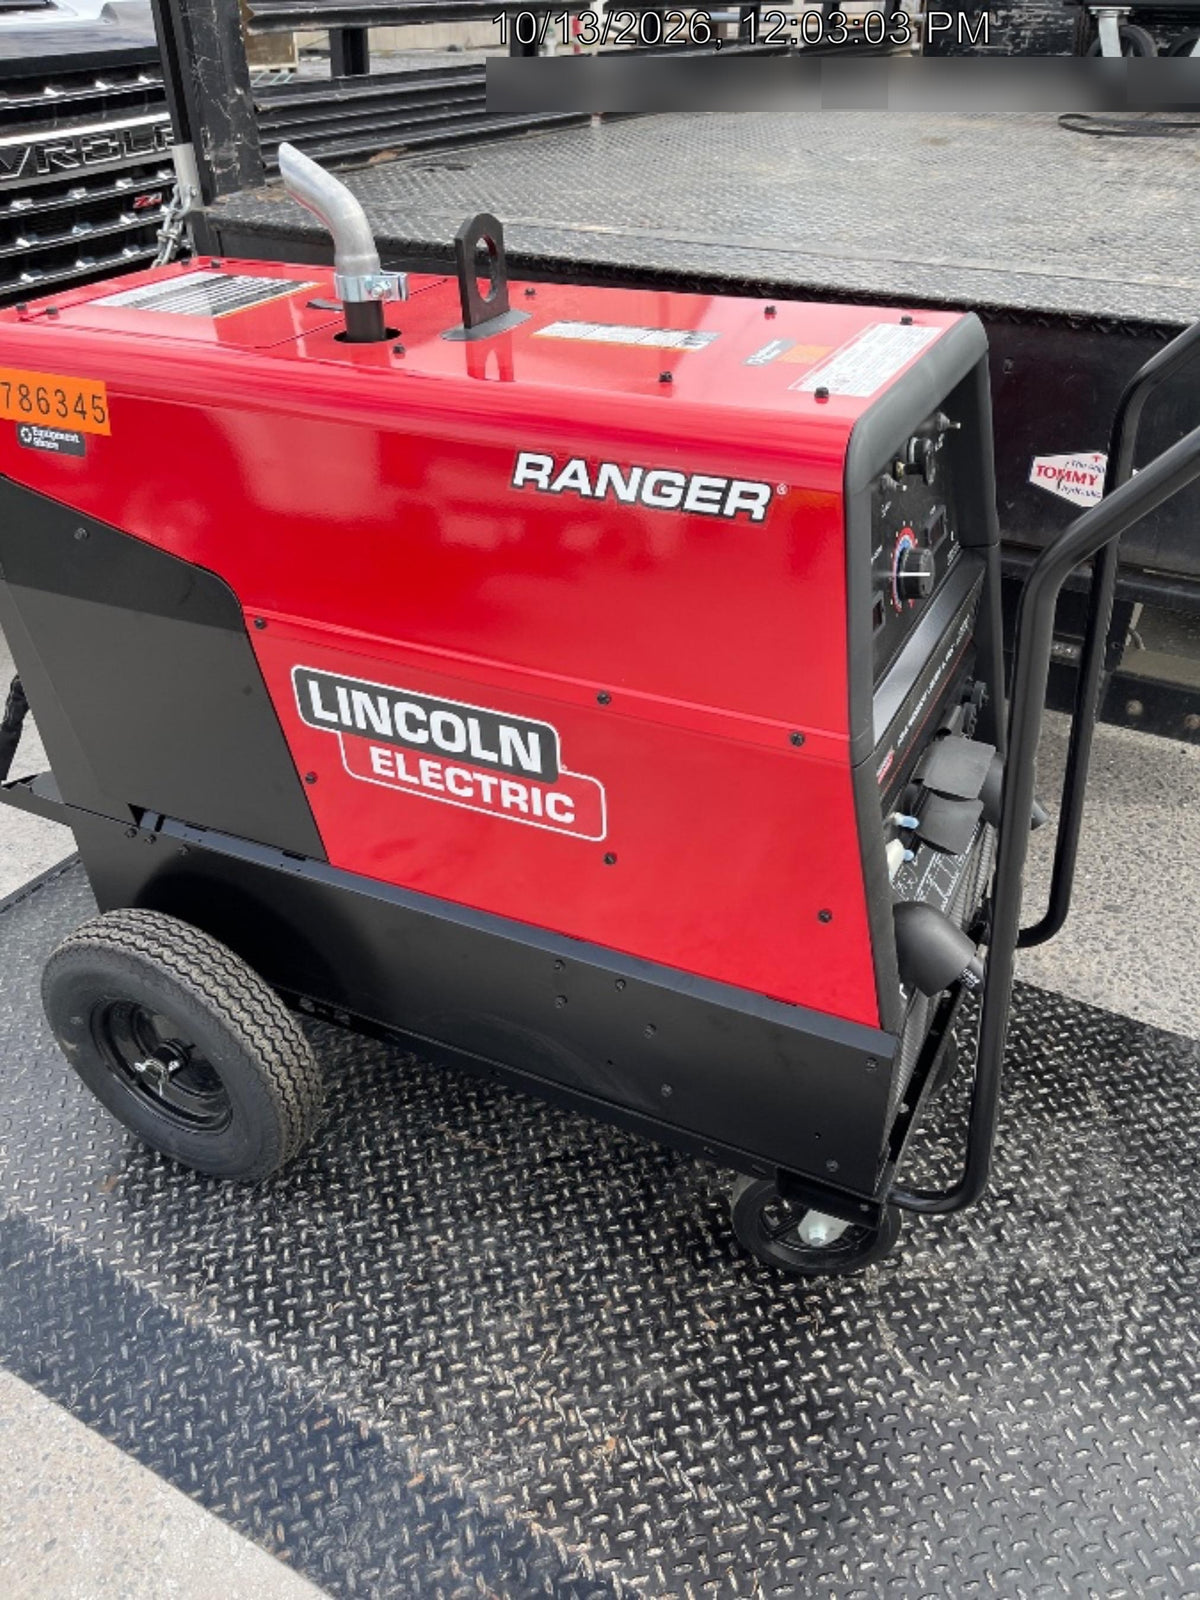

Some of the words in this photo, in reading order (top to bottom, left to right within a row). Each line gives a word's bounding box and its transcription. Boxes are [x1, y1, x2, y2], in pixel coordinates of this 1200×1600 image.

[0, 381, 106, 424] 786345
[511, 450, 773, 523] RANGER
[1036, 465, 1098, 486] TOMMY
[308, 680, 542, 773] LINCOLN
[370, 746, 576, 824] ELECTRIC
